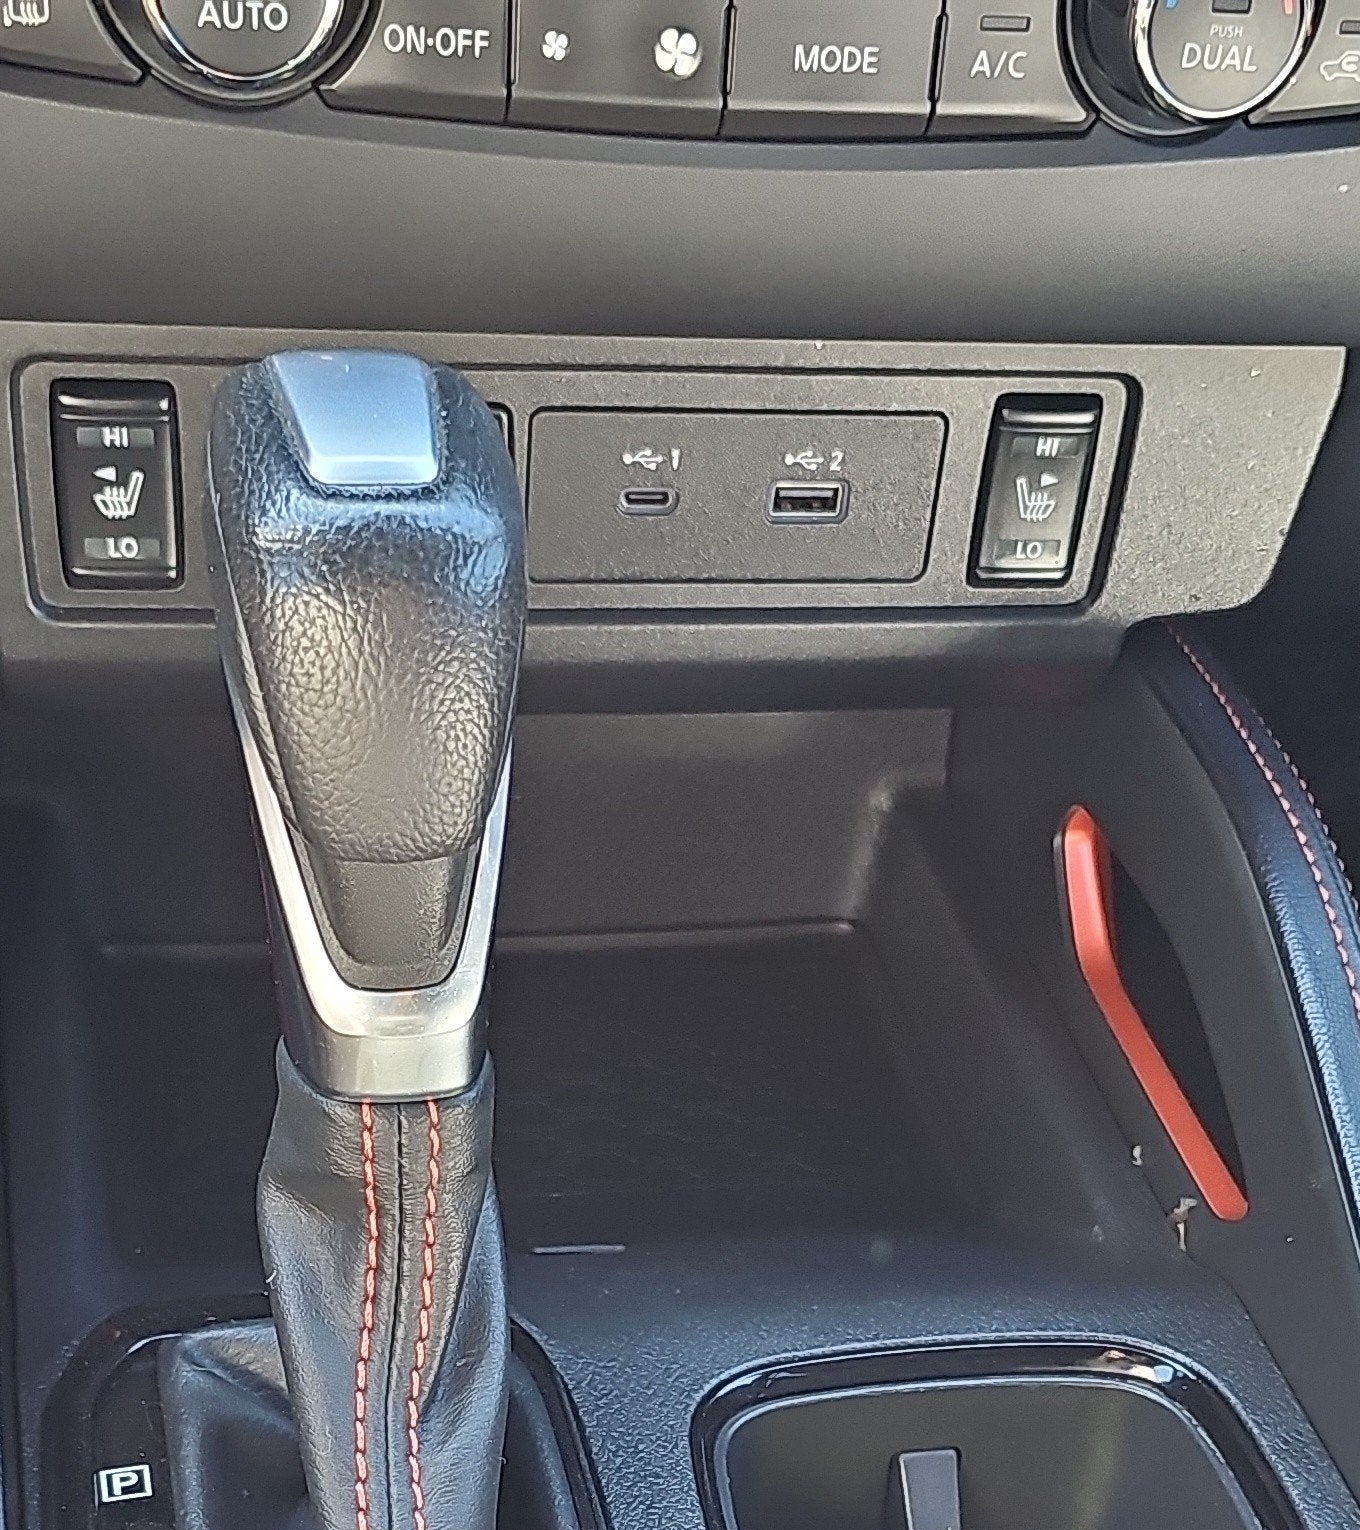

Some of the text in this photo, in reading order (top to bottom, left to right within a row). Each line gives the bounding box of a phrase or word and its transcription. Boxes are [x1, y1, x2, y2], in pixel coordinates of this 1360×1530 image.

[197, 0, 288, 31] AUTO
[1209, 25, 1244, 38] PUSH
[793, 44, 880, 75] MODE
[970, 49, 1028, 80] A/C
[1181, 42, 1258, 72] DUAL
[101, 425, 130, 448] HI
[1036, 436, 1061, 457] HI
[671, 448, 681, 471] 1
[829, 451, 845, 472] 2
[105, 536, 140, 558] LO
[1015, 541, 1043, 559] LO
